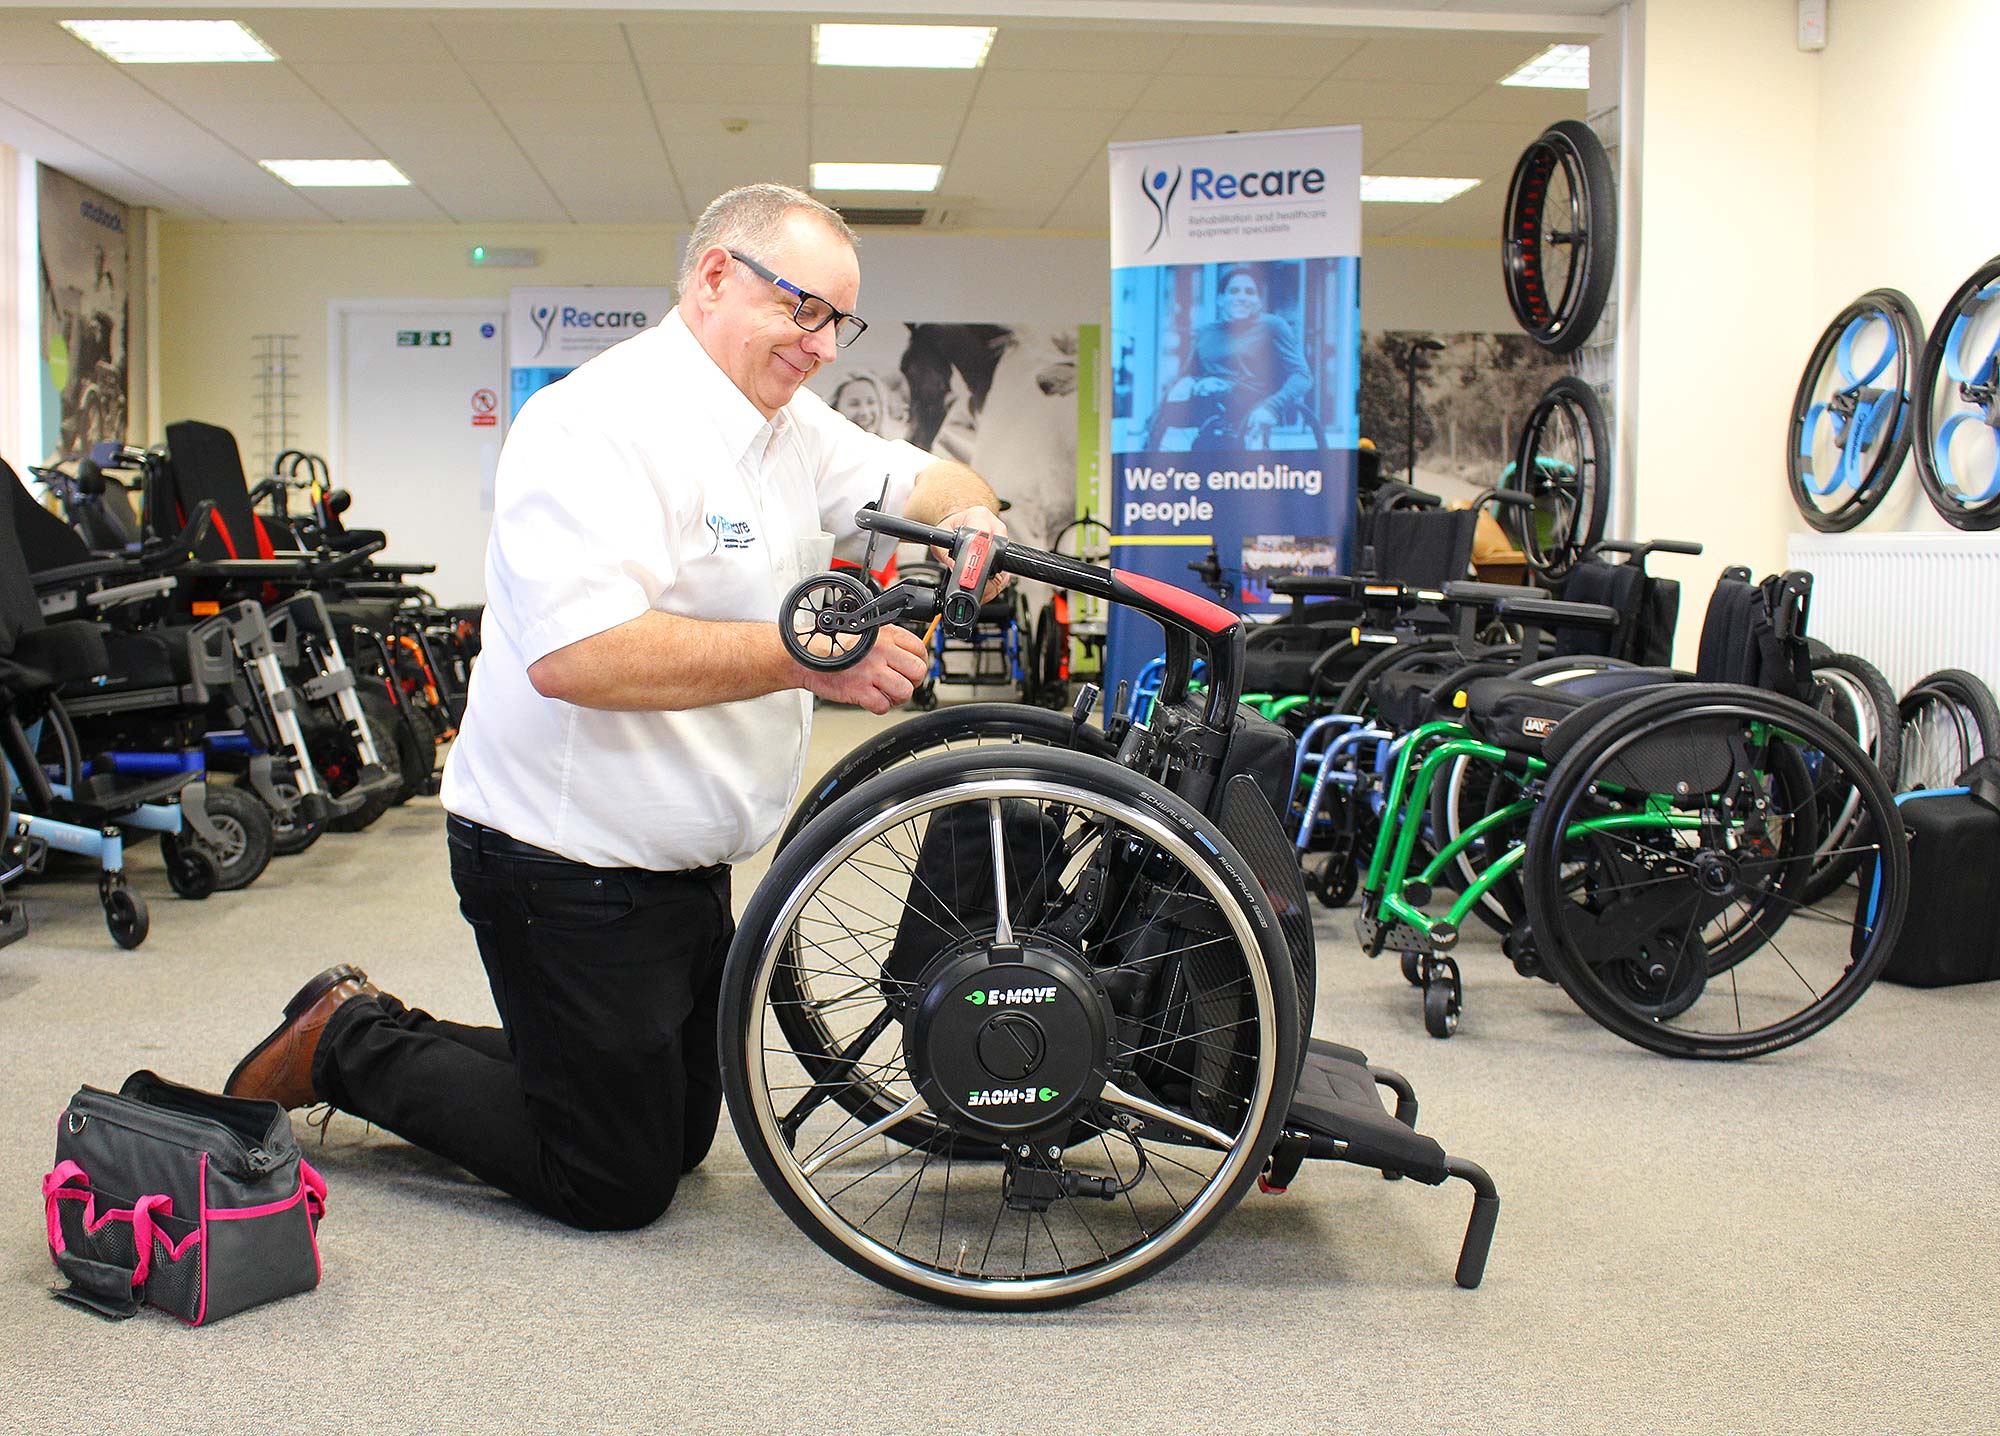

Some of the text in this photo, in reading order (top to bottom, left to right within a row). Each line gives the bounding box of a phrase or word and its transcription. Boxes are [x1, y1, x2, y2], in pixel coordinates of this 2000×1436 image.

[1190, 168, 1326, 201] Recare
[1255, 211, 1274, 222] and
[1276, 208, 1328, 221] healthcare
[1188, 226, 1241, 239] equipment
[562, 306, 647, 328] Recare
[1124, 463, 1323, 496] We're enabling
[1124, 495, 1214, 527] people
[1138, 790, 1256, 904] SCHWALBE RIGHTRUN
